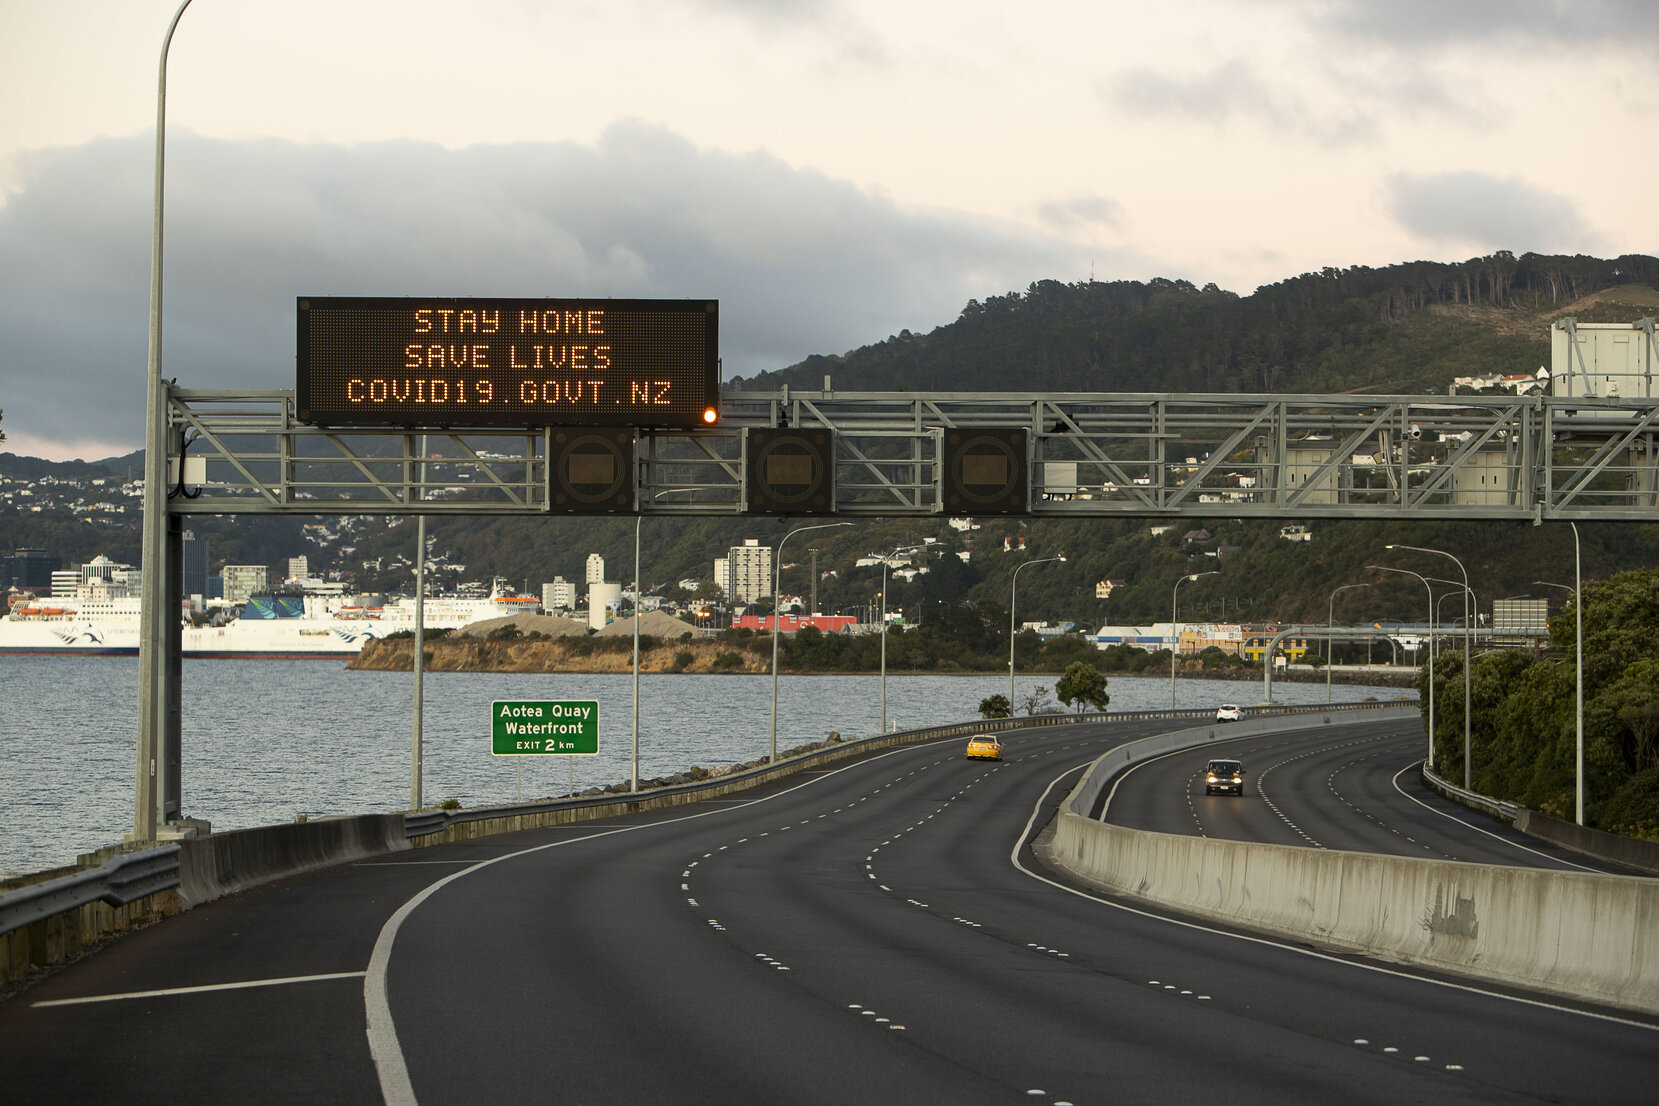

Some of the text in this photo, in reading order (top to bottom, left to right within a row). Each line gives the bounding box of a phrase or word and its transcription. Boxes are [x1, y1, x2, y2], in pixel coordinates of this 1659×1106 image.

[415, 309, 605, 334] STAY HOME
[405, 345, 611, 369] SAVE LIVES
[500, 704, 591, 720] Aotea Quay
[505, 721, 584, 735] Waterfront
[516, 739, 575, 751] EXIT 2 km
